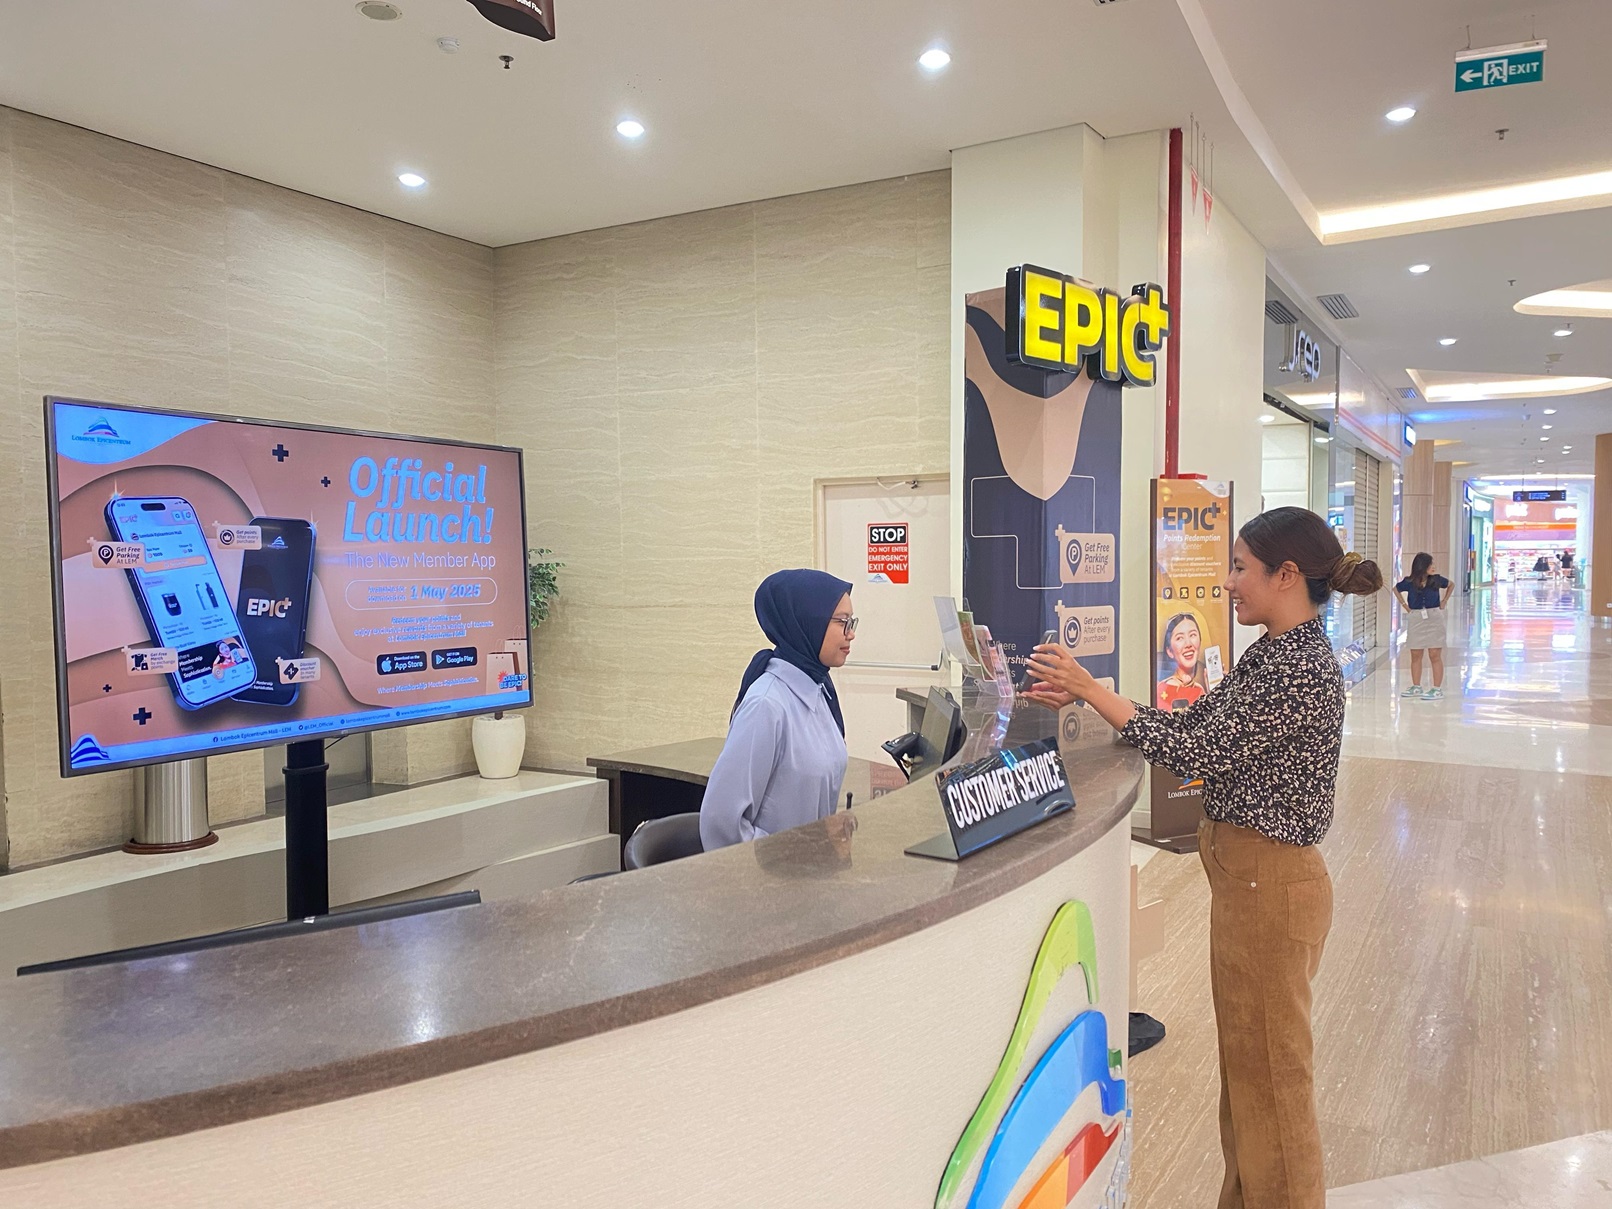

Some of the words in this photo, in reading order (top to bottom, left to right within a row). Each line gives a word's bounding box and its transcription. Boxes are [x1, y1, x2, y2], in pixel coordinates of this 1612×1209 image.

[1508, 62, 1540, 76] EXIT
[1022, 268, 1170, 383] EPIC+
[348, 456, 487, 509] Official
[1162, 502, 1221, 530] EPIC+
[342, 501, 494, 544] Launch!
[872, 528, 905, 542] STOP
[1164, 534, 1183, 542] Points
[1184, 534, 1221, 544] Redemption
[1084, 542, 1095, 552] Get
[1096, 542, 1110, 552] Free
[344, 551, 373, 568] The
[378, 552, 410, 567] New
[414, 552, 468, 568] Member
[471, 553, 496, 570] App
[1084, 554, 1108, 565] Parking
[1084, 565, 1091, 574] At
[1093, 565, 1105, 574] LEM
[410, 586, 418, 600] 1
[422, 585, 448, 602] May
[450, 584, 481, 598] 2025
[246, 597, 292, 618] EPIC+
[1093, 616, 1109, 626] points
[354, 629, 372, 637] enjoy
[1084, 634, 1106, 645] purchase
[394, 662, 407, 670] App
[241, 731, 267, 740] Epicentrum
[946, 766, 1020, 829] CUSTOMER
[1014, 750, 1065, 802] SERVICE
[1168, 790, 1189, 798] LOMBOK
